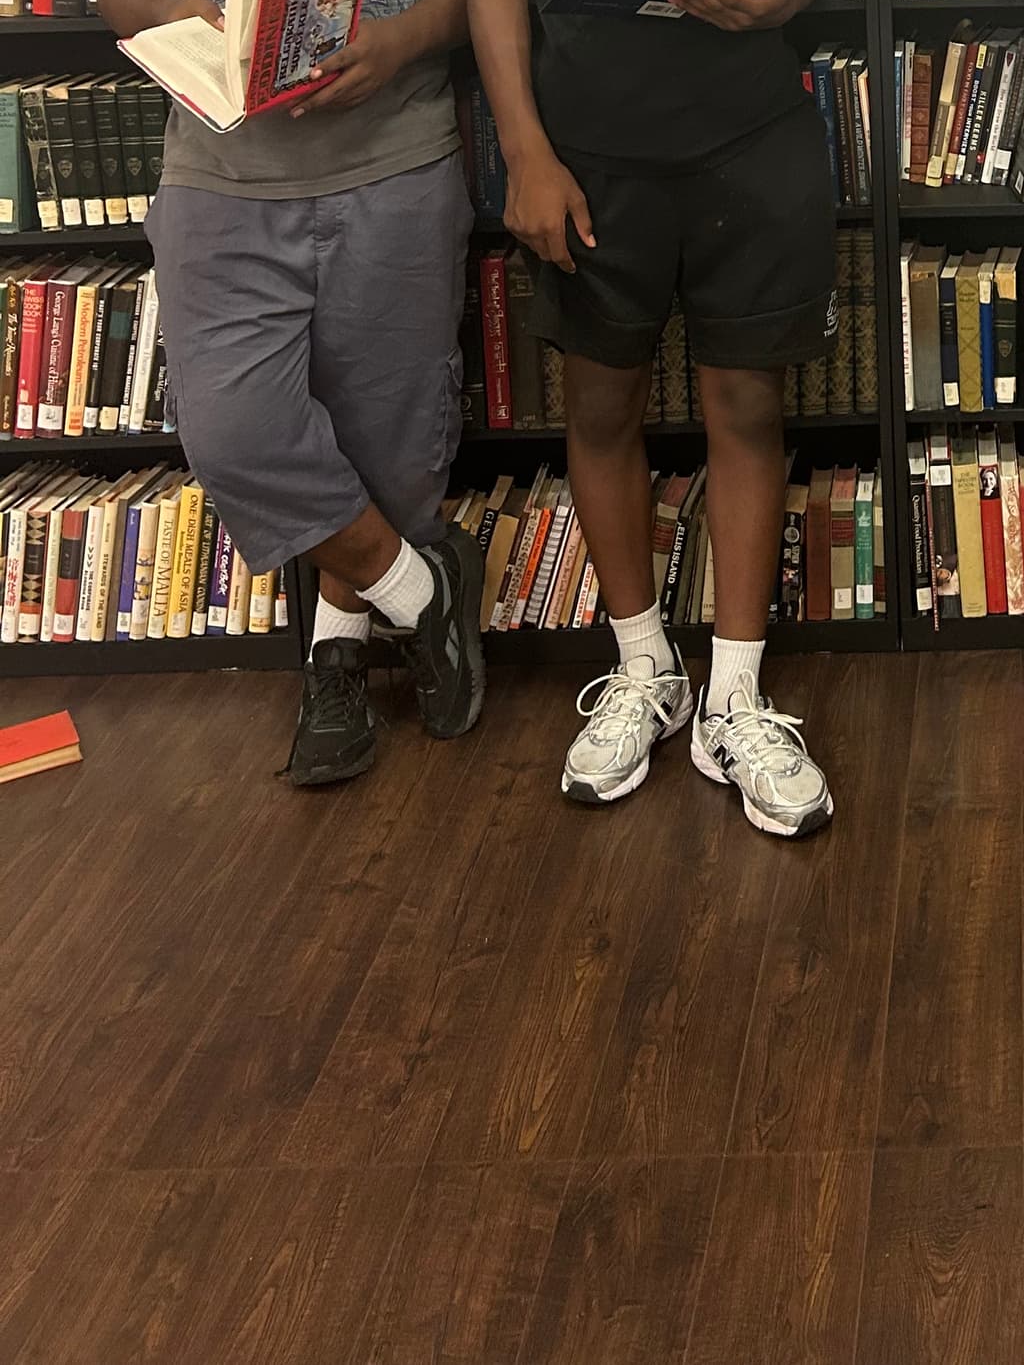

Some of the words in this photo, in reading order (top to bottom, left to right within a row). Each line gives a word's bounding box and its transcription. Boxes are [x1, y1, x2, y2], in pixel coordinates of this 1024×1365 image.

[976, 90, 987, 121] KILLER
[961, 117, 972, 154] INTERVIEW
[970, 123, 981, 152] GERMS
[53, 291, 65, 316] George
[79, 301, 91, 339] Modern
[75, 339, 88, 383] Petroleum
[188, 494, 199, 541] ONE-DISH
[162, 519, 174, 550] TASTE
[674, 525, 686, 553] ELLIS
[161, 551, 170, 565] OF
[185, 543, 195, 574] MEALS
[668, 553, 681, 585] ISLAND
[154, 566, 172, 618] MALTA
[182, 577, 191, 590] OF
[178, 591, 189, 613] ASIA
